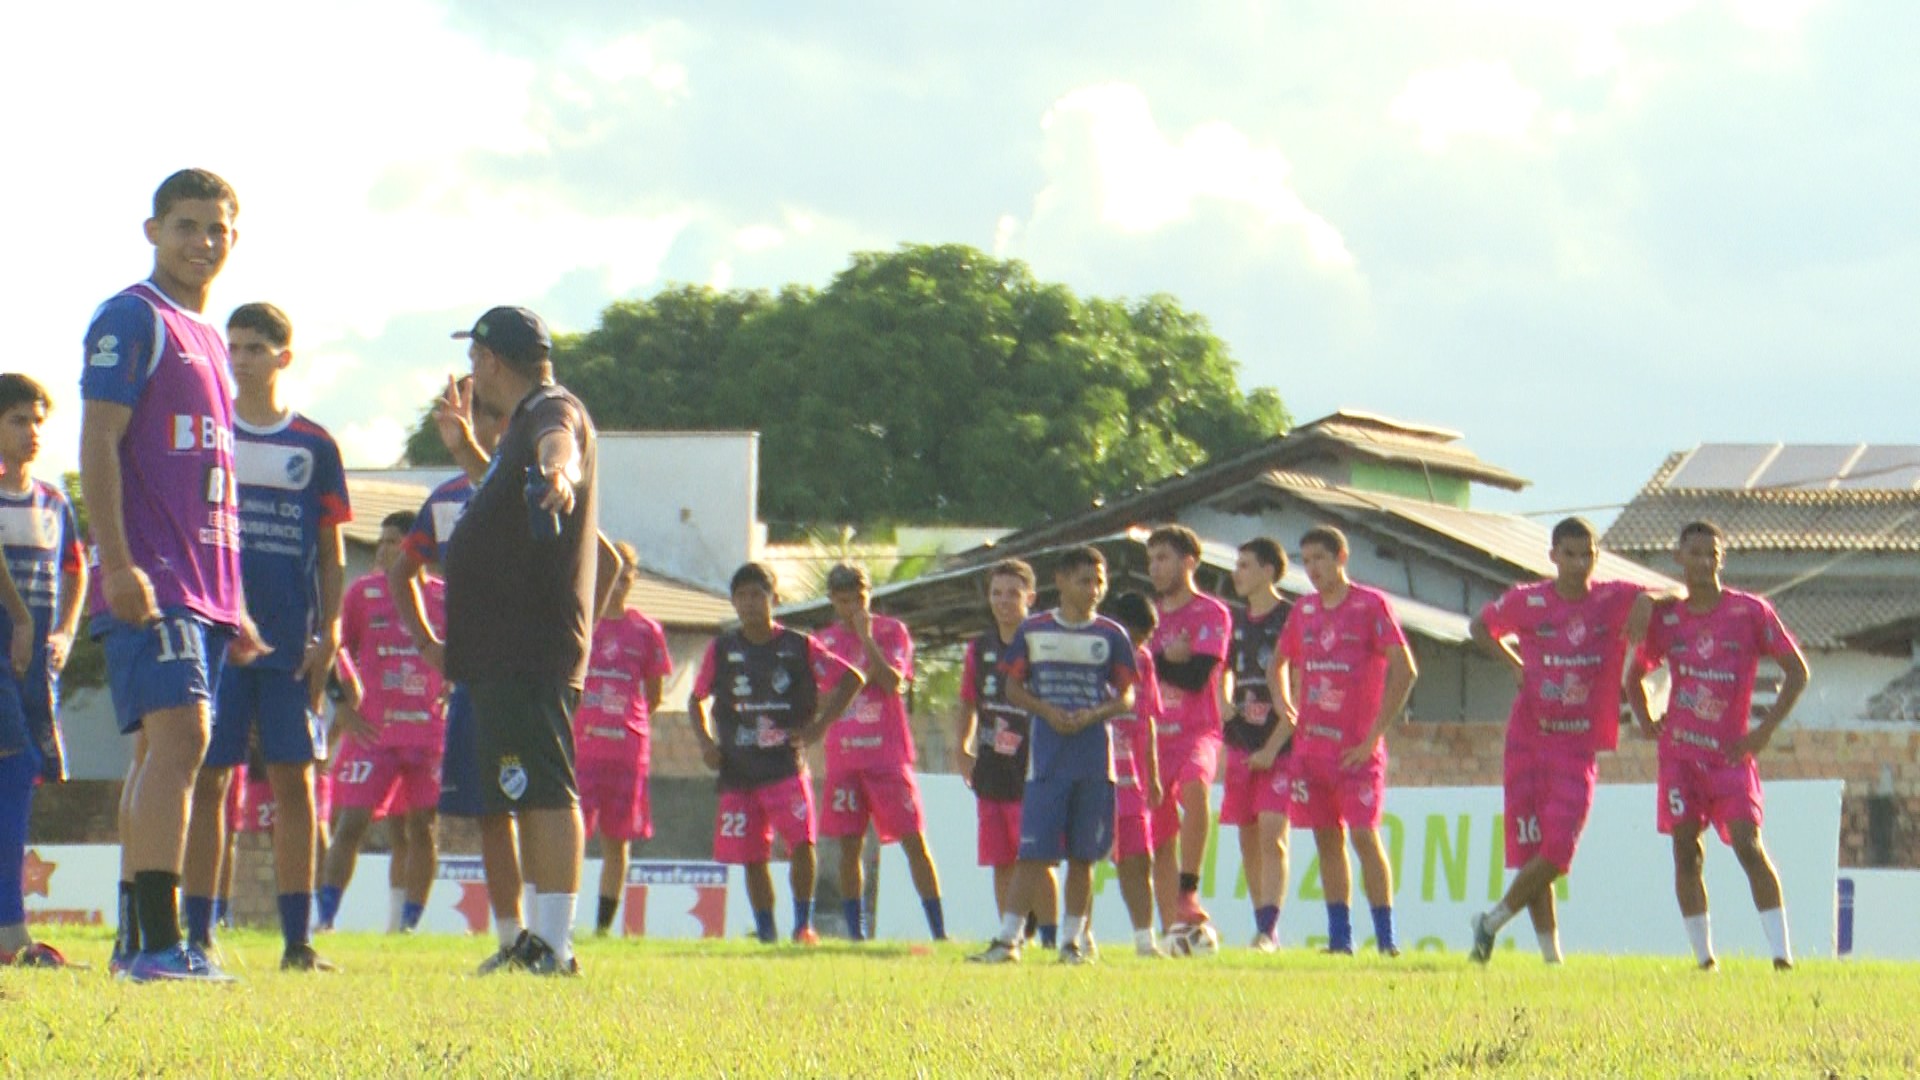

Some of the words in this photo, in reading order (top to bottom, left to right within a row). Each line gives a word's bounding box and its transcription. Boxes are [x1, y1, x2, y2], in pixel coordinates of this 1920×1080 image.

[153, 619, 197, 662] 11
[1668, 788, 1685, 816] 5
[721, 812, 748, 837] 22
[1516, 815, 1543, 845] 16
